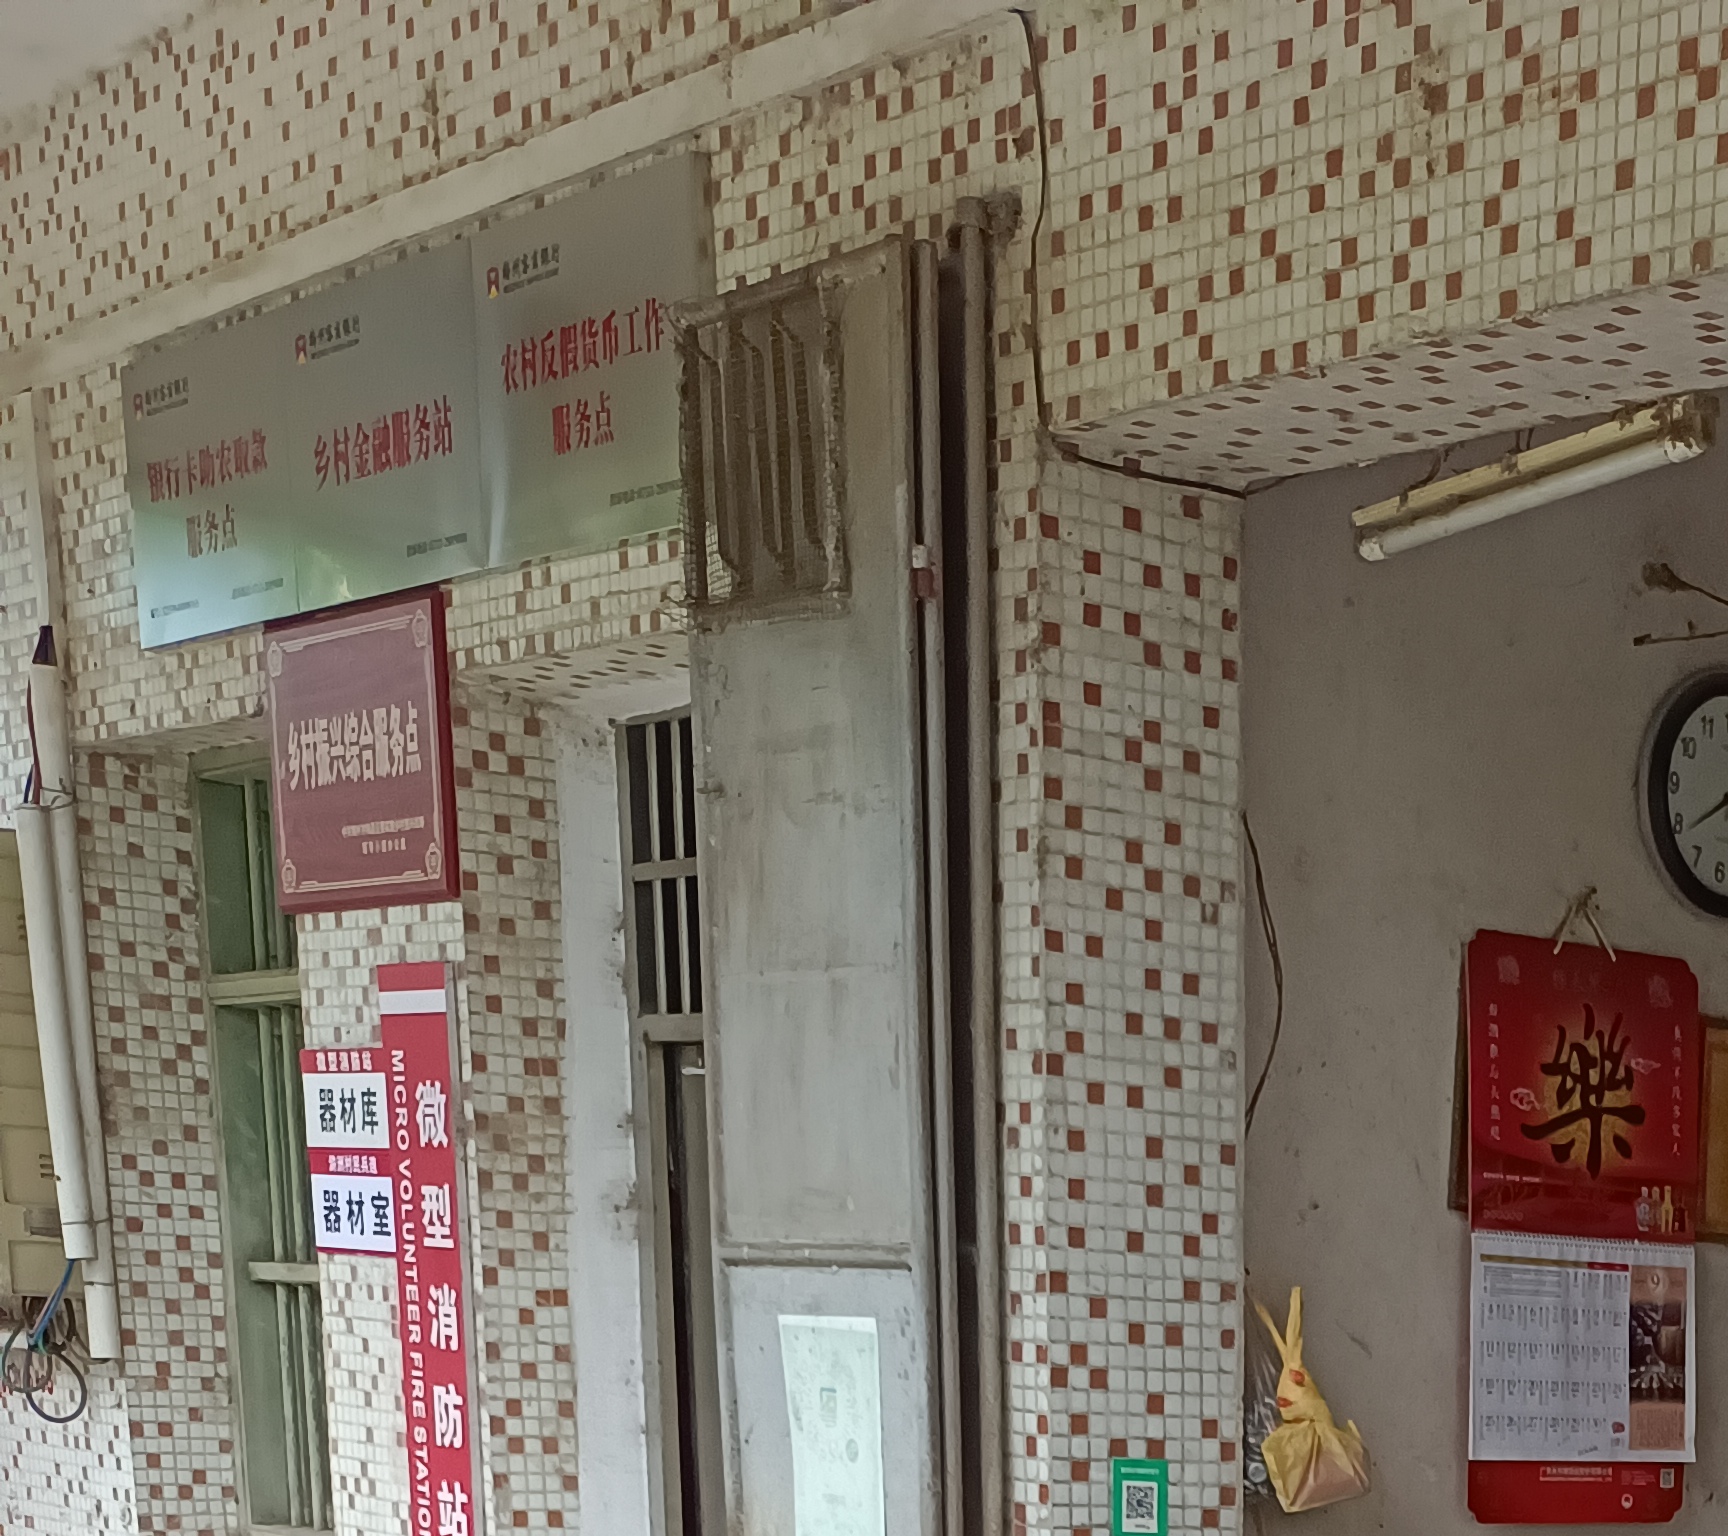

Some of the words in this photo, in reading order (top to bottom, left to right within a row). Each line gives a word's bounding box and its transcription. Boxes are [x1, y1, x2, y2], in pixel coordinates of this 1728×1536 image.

[501, 297, 664, 395] 农村反假货币工作
[313, 394, 454, 492] 乡村金融服务站
[552, 390, 614, 456] 服务点
[147, 428, 268, 503] 银行卡助农取款
[288, 701, 422, 791] 乡村振兴综合服务点
[1681, 736, 1697, 759] 10
[1701, 715, 1715, 740] 11
[1669, 771, 1680, 794] 9
[1674, 812, 1683, 835] 8
[1692, 844, 1702, 868] 7
[1714, 861, 1725, 884] 6
[319, 1087, 379, 1135] 器材库
[391, 1050, 410, 1151] MICRO
[323, 1190, 392, 1237] 器材室
[398, 1158, 422, 1345] VOLUNTEER
[409, 1351, 425, 1418] FIRE
